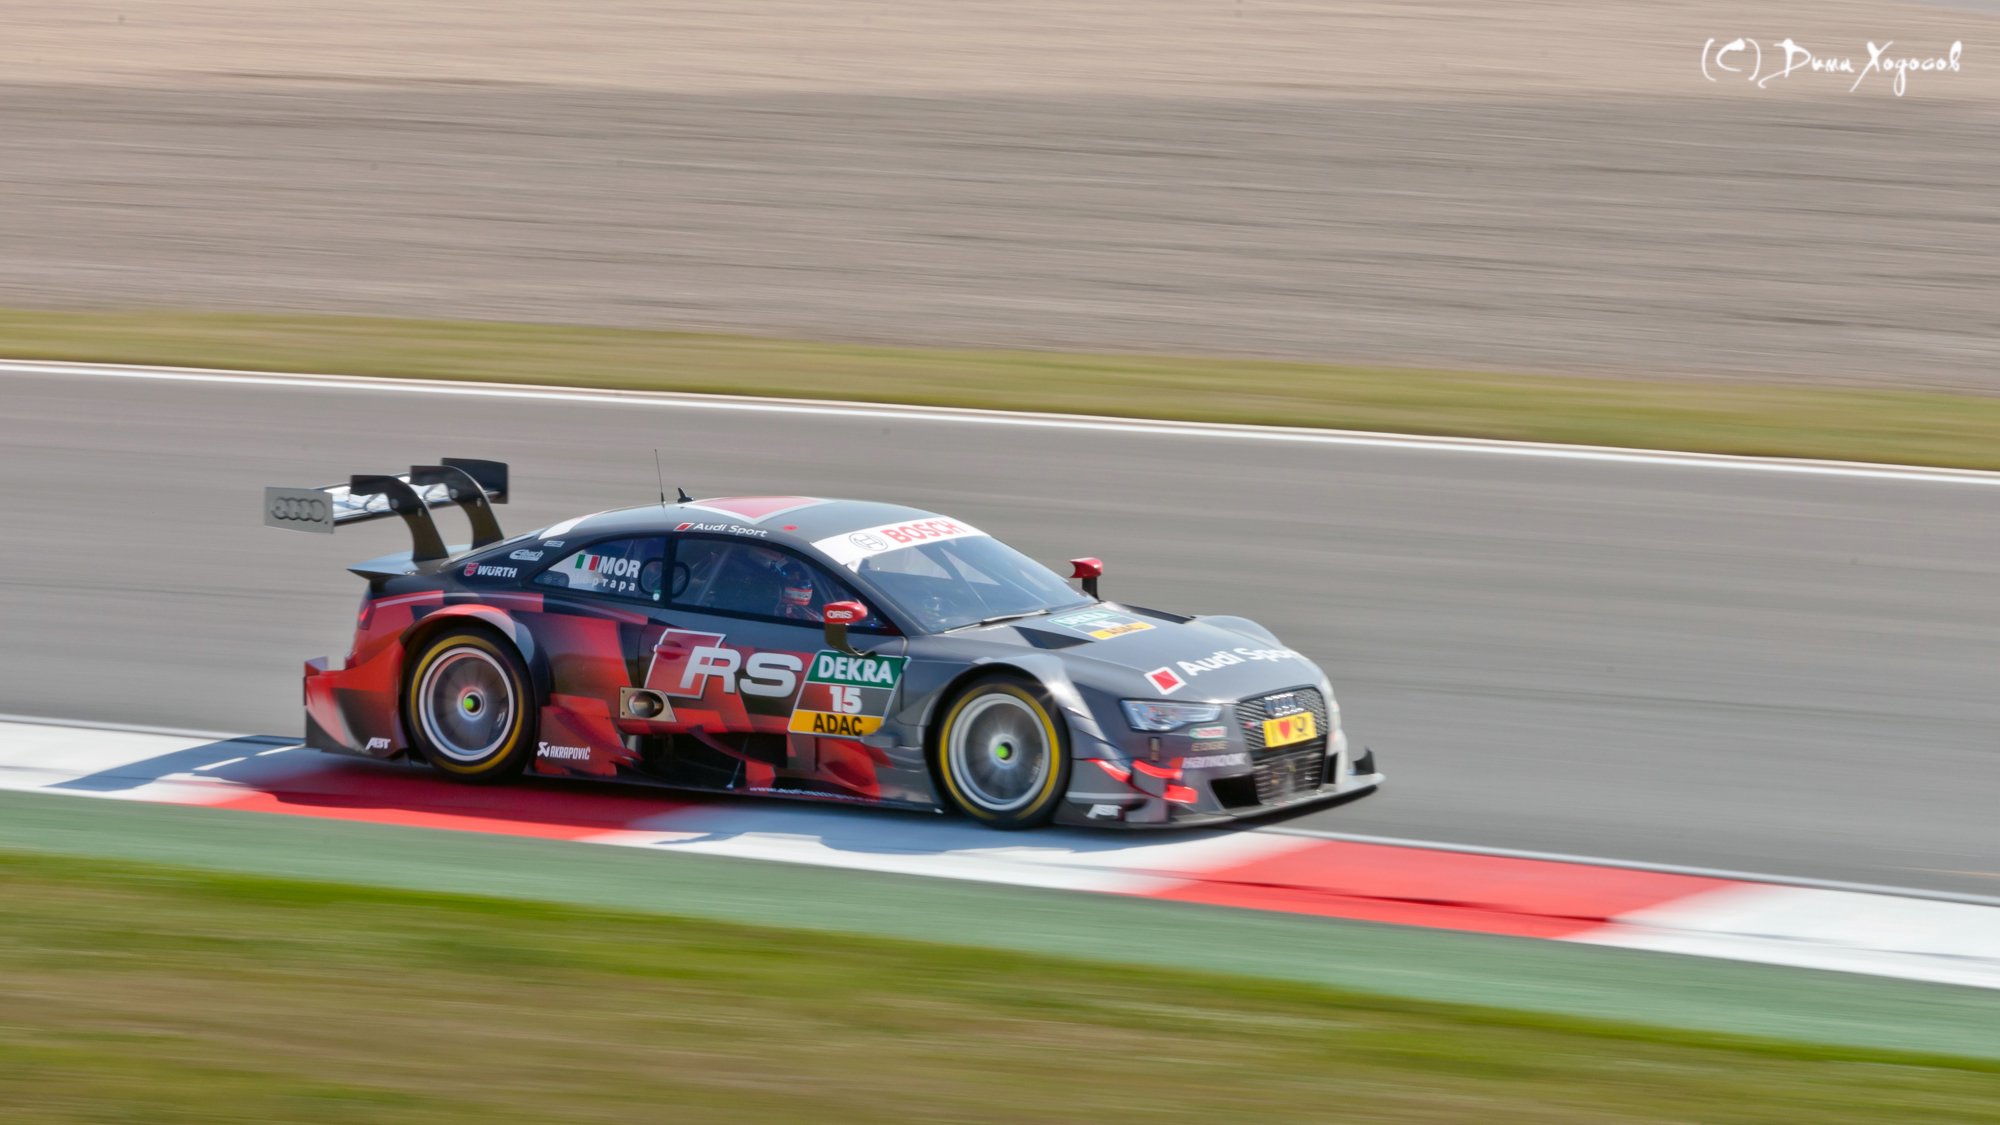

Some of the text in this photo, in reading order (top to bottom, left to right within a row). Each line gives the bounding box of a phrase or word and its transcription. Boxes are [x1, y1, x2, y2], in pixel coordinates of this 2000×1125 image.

[693, 523, 768, 537] Audi Sport
[880, 519, 967, 544] BOSCH
[477, 565, 518, 578] WÜRTH
[598, 555, 641, 578] MOR
[826, 609, 854, 619] ORIS
[680, 645, 803, 697] RS
[817, 654, 894, 684] DEKRA
[1175, 650, 1246, 676] Audi
[829, 686, 863, 714] 15
[812, 713, 864, 737] ADAC
